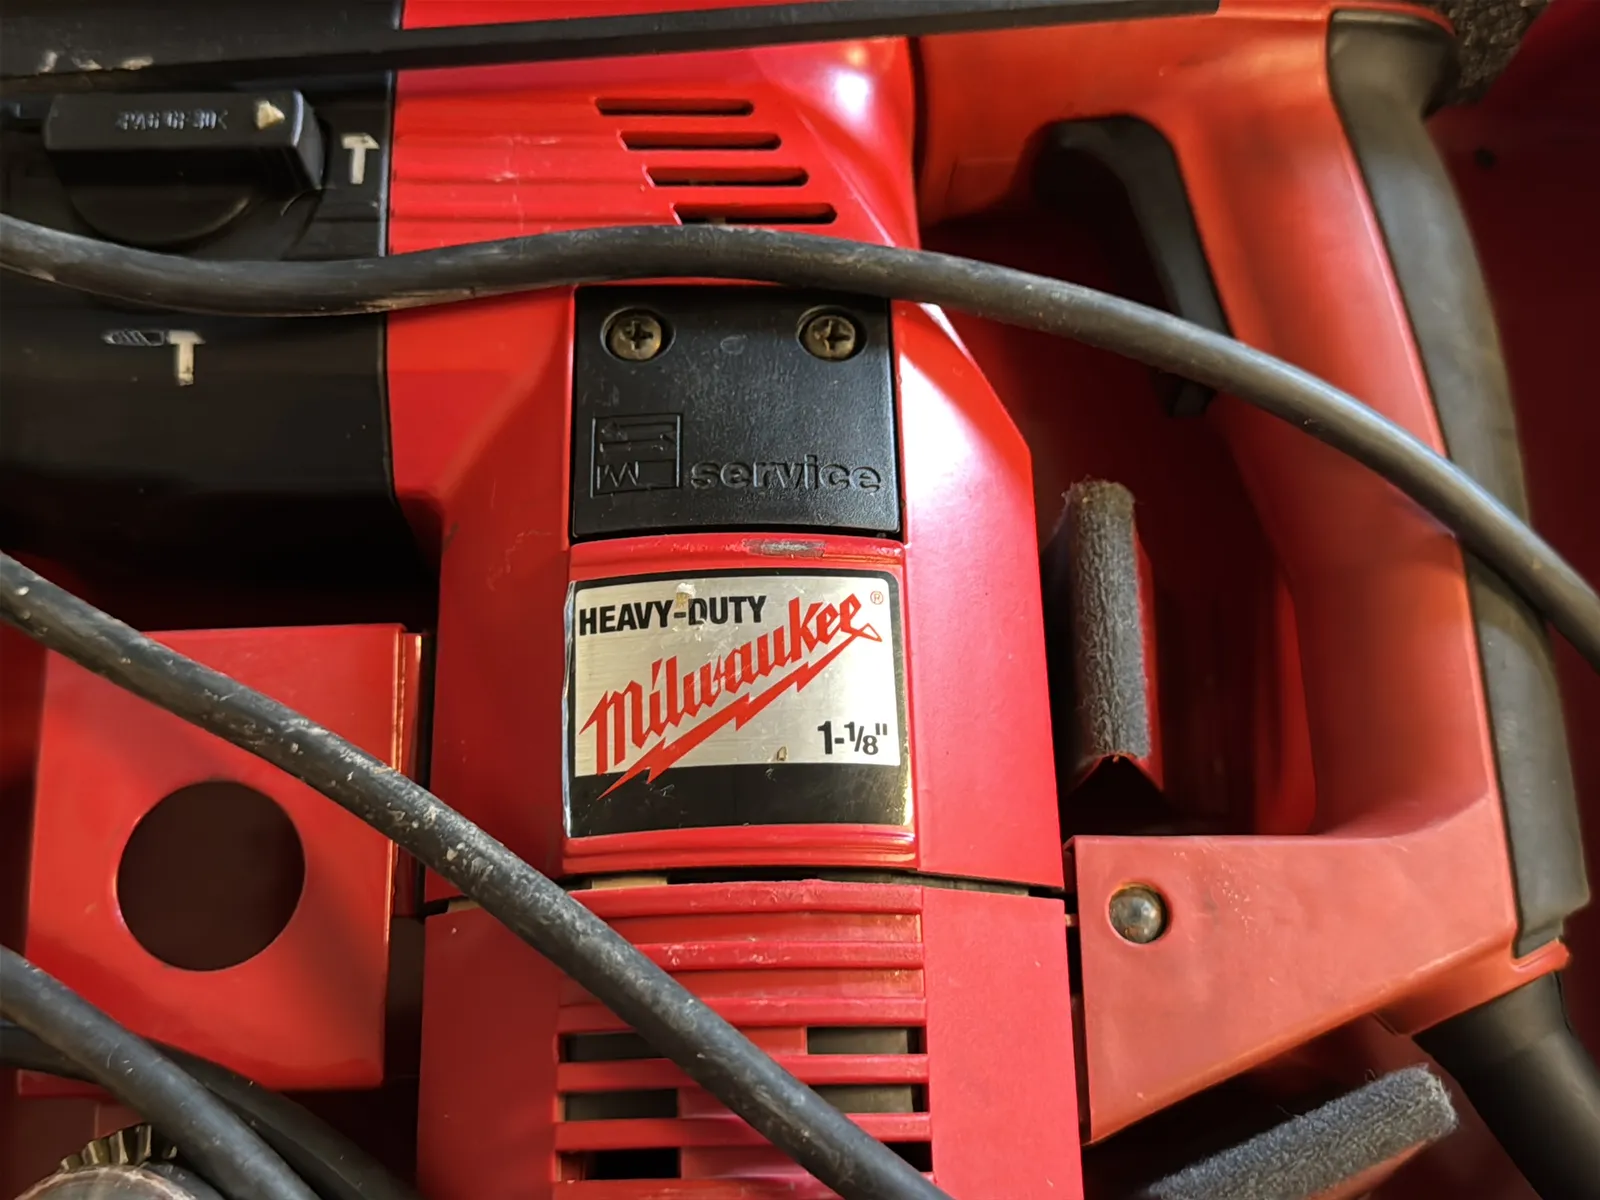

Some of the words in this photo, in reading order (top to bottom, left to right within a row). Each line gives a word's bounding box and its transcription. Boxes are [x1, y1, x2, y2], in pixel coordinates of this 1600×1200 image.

[690, 454, 882, 494] service
[579, 595, 767, 636] HEAVY-DUTY
[579, 593, 882, 777] Milwaukee
